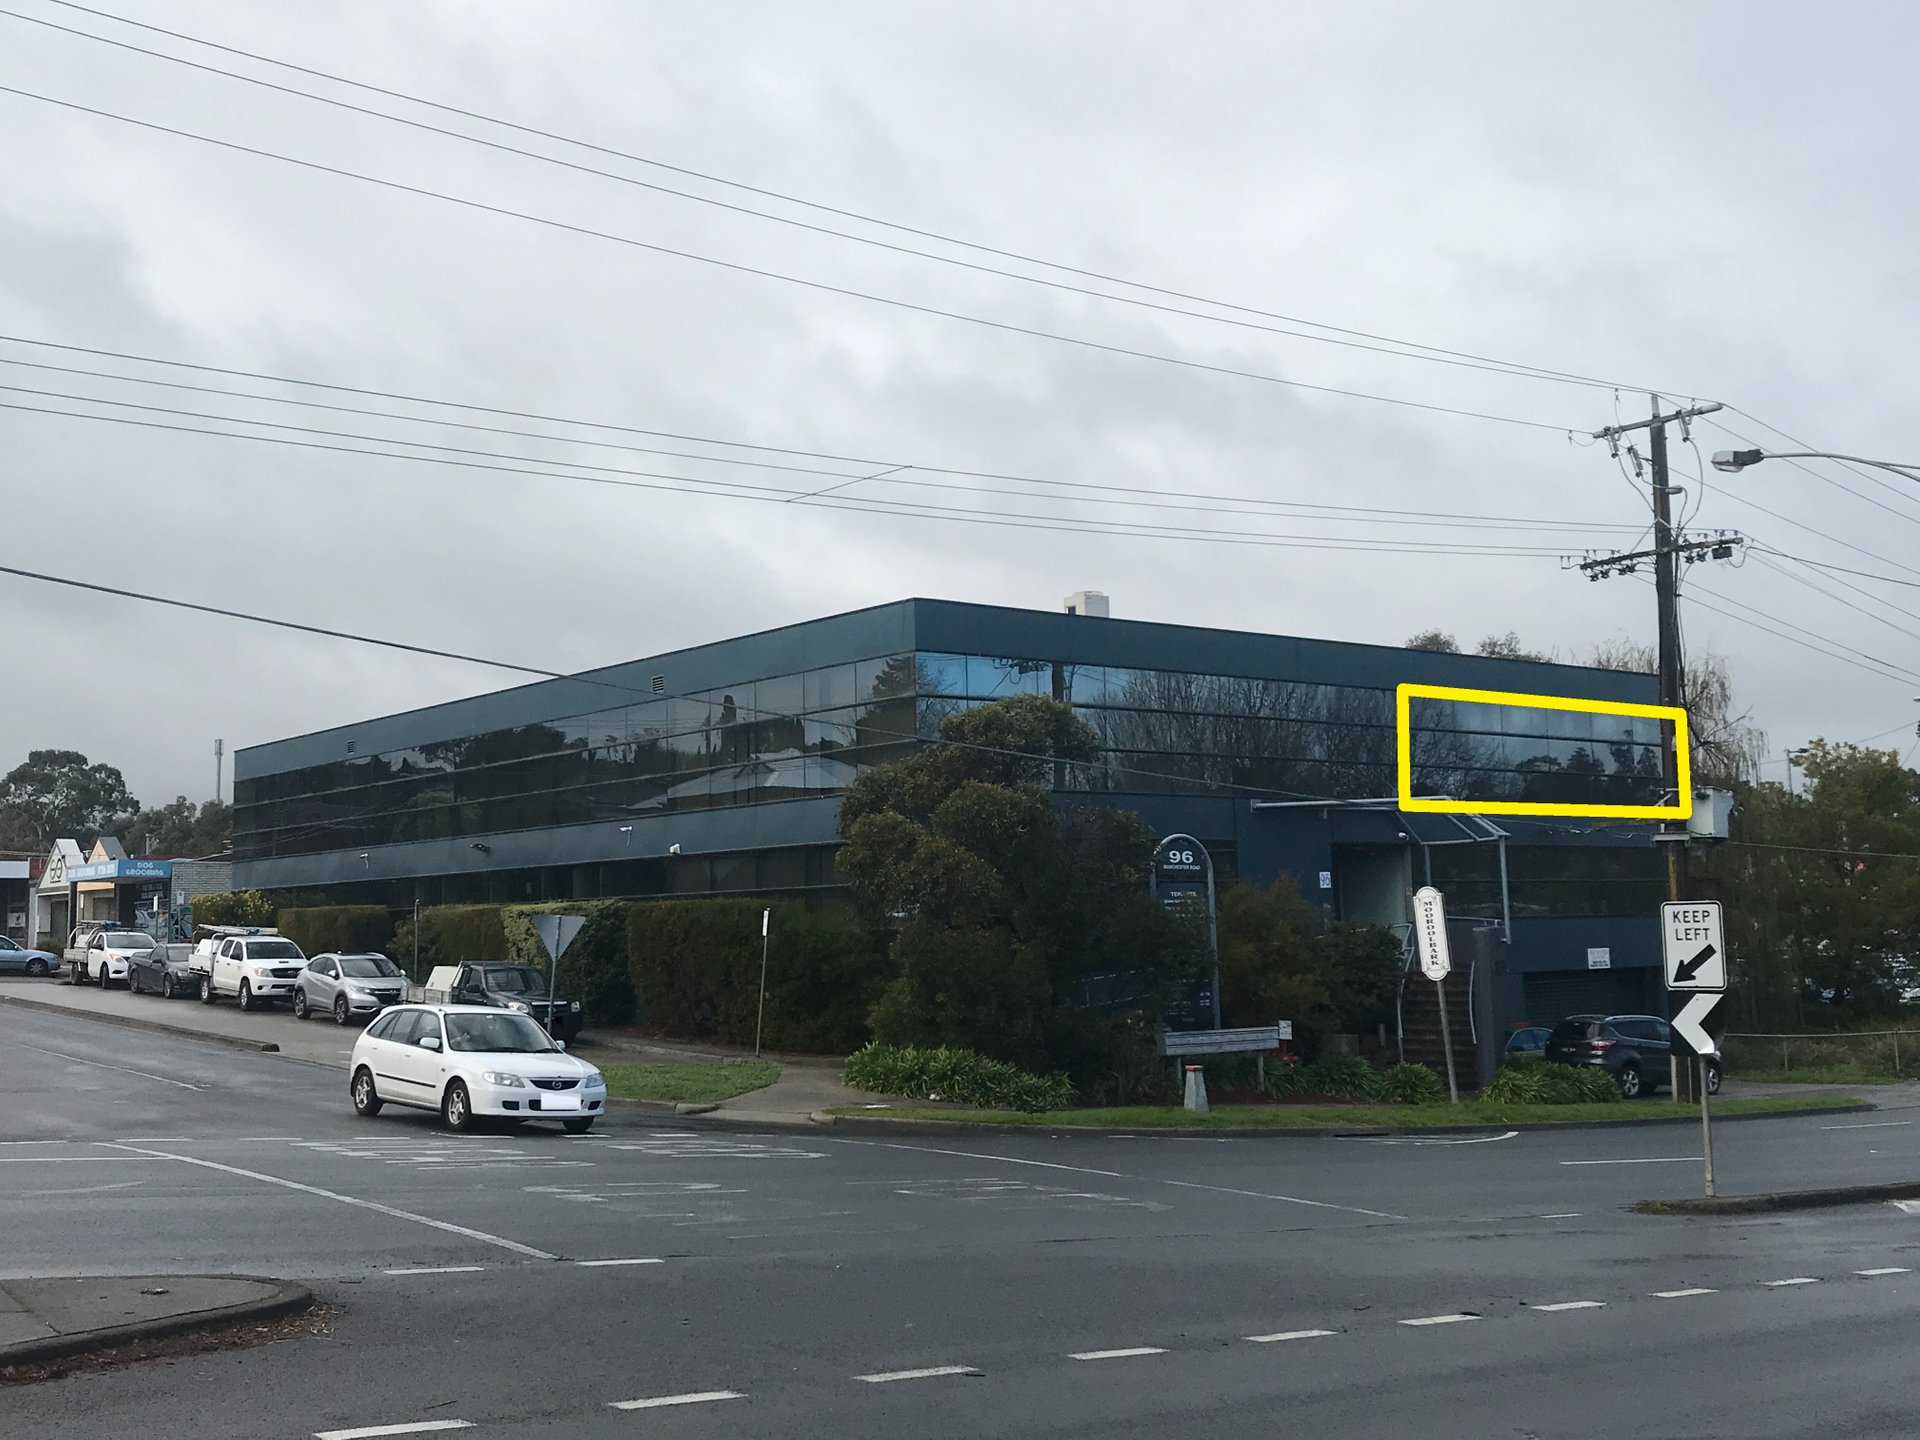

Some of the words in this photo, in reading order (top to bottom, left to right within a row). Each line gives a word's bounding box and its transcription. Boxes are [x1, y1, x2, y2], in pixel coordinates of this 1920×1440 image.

[1169, 850, 1194, 864] 96
[126, 868, 164, 876] GROOMING
[1672, 910, 1711, 923] KEEP
[1423, 901, 1439, 966] MOOROOLBARK
[1675, 927, 1710, 941] LEFT
